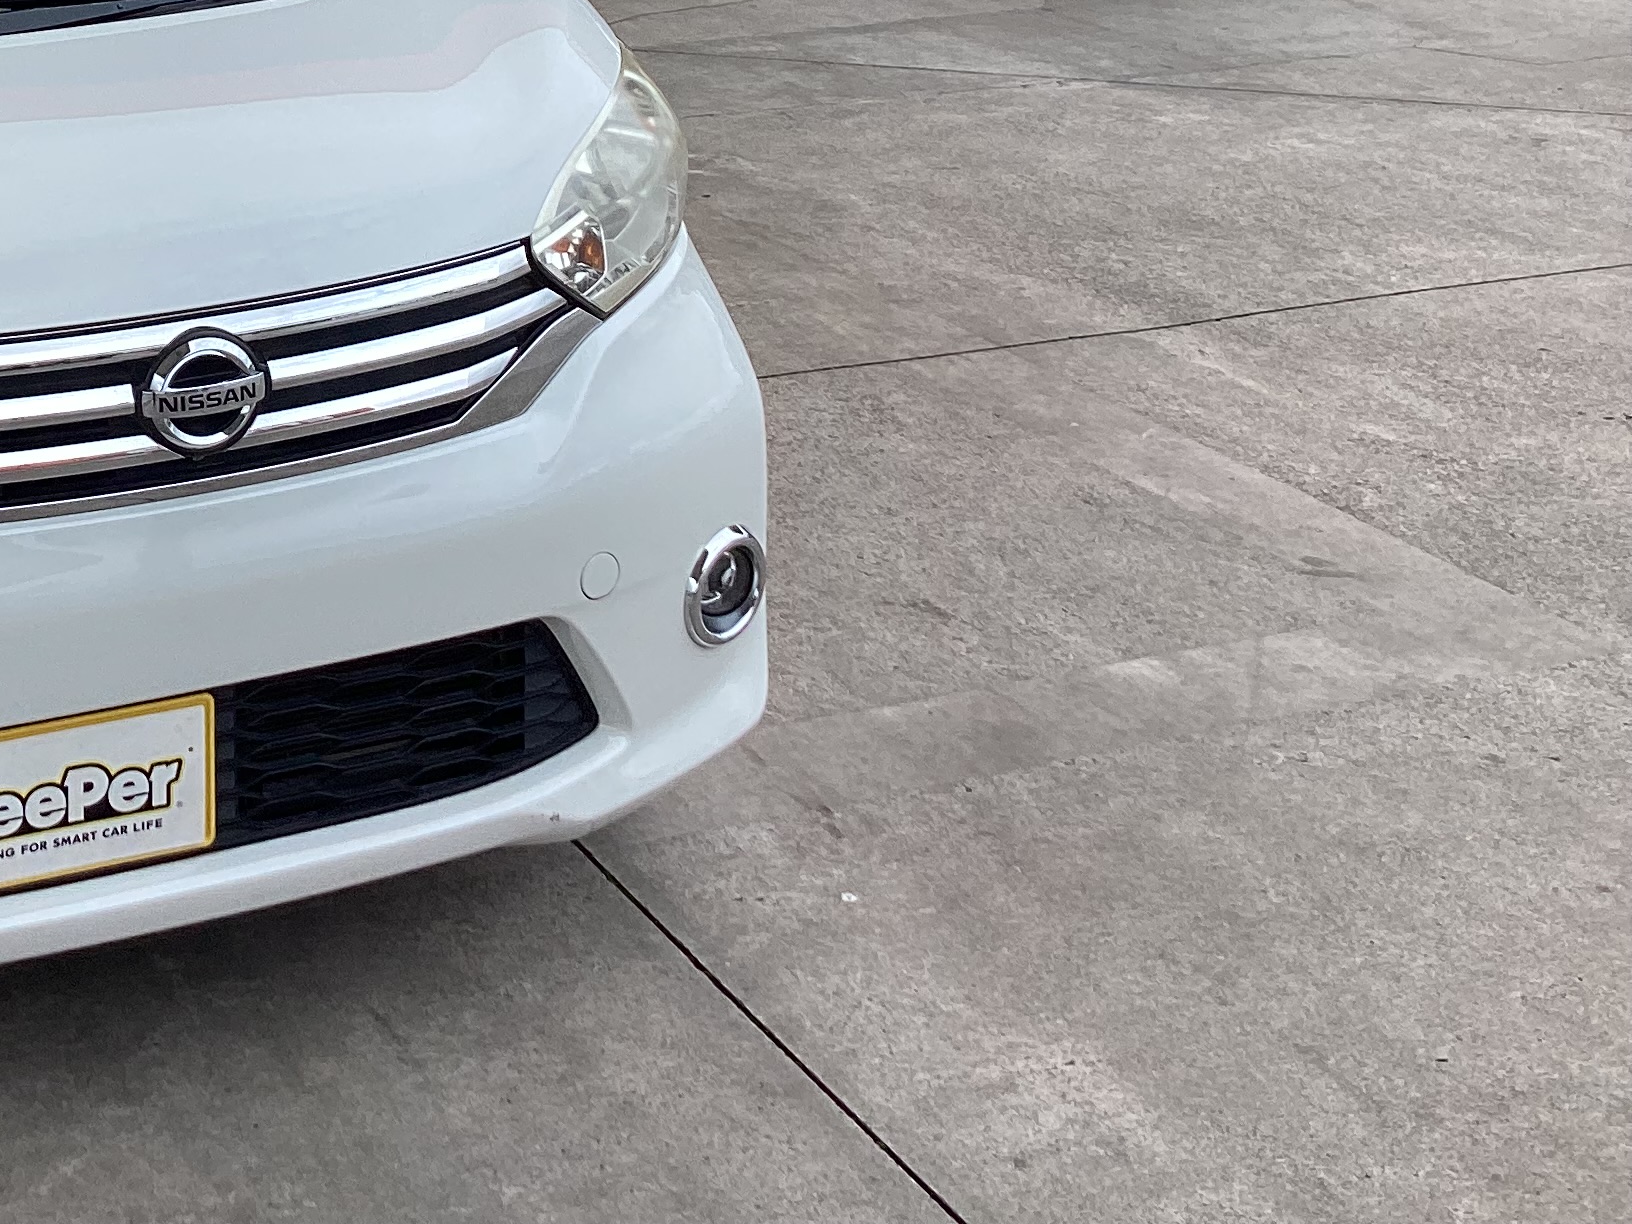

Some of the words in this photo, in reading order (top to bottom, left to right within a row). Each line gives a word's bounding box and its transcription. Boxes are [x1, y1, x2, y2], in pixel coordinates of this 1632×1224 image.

[157, 381, 258, 414] NISSAN
[21, 840, 48, 856] FOR
[53, 831, 98, 850] SMART
[102, 825, 130, 840] CAR
[133, 818, 164, 835] LIFE
